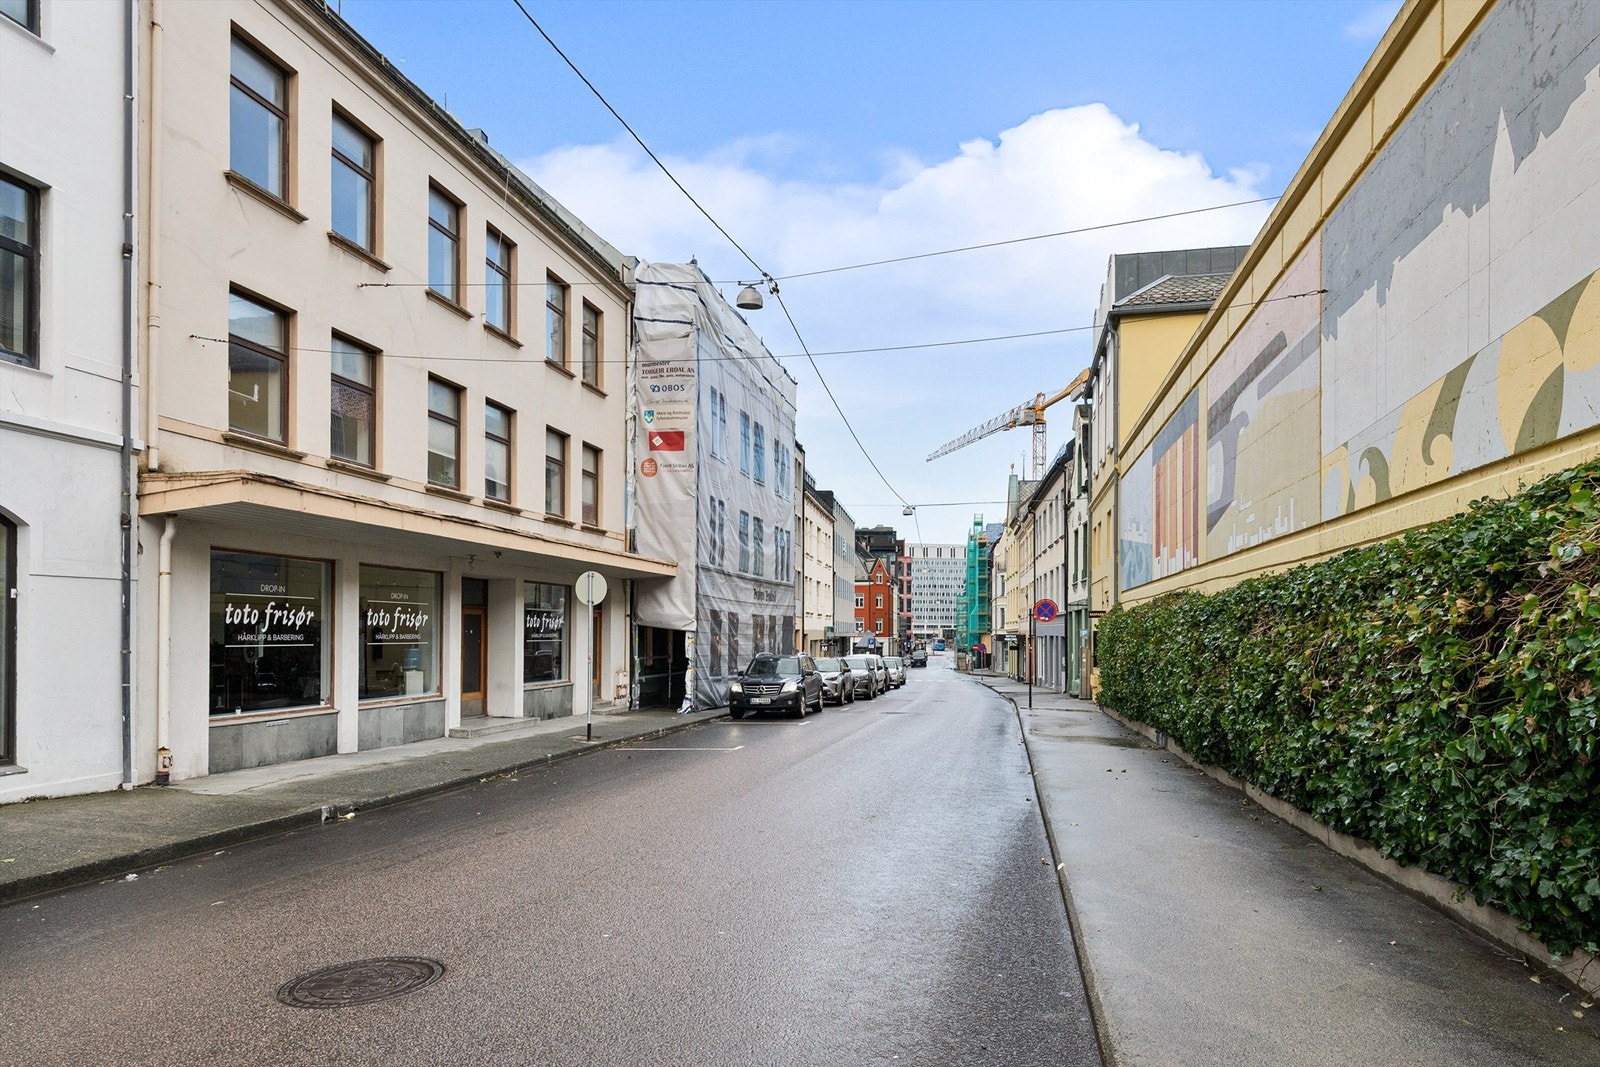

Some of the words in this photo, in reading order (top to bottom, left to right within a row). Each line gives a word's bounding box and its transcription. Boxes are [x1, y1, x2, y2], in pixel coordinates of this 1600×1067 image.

[260, 584, 286, 592] DROP-IN
[226, 603, 258, 624] toto
[262, 602, 314, 632] frisør
[367, 608, 390, 626] toto
[391, 607, 428, 632] frisør
[526, 614, 540, 627] toto
[540, 613, 563, 632] frisør
[238, 632, 266, 640] HÅRKLIPP
